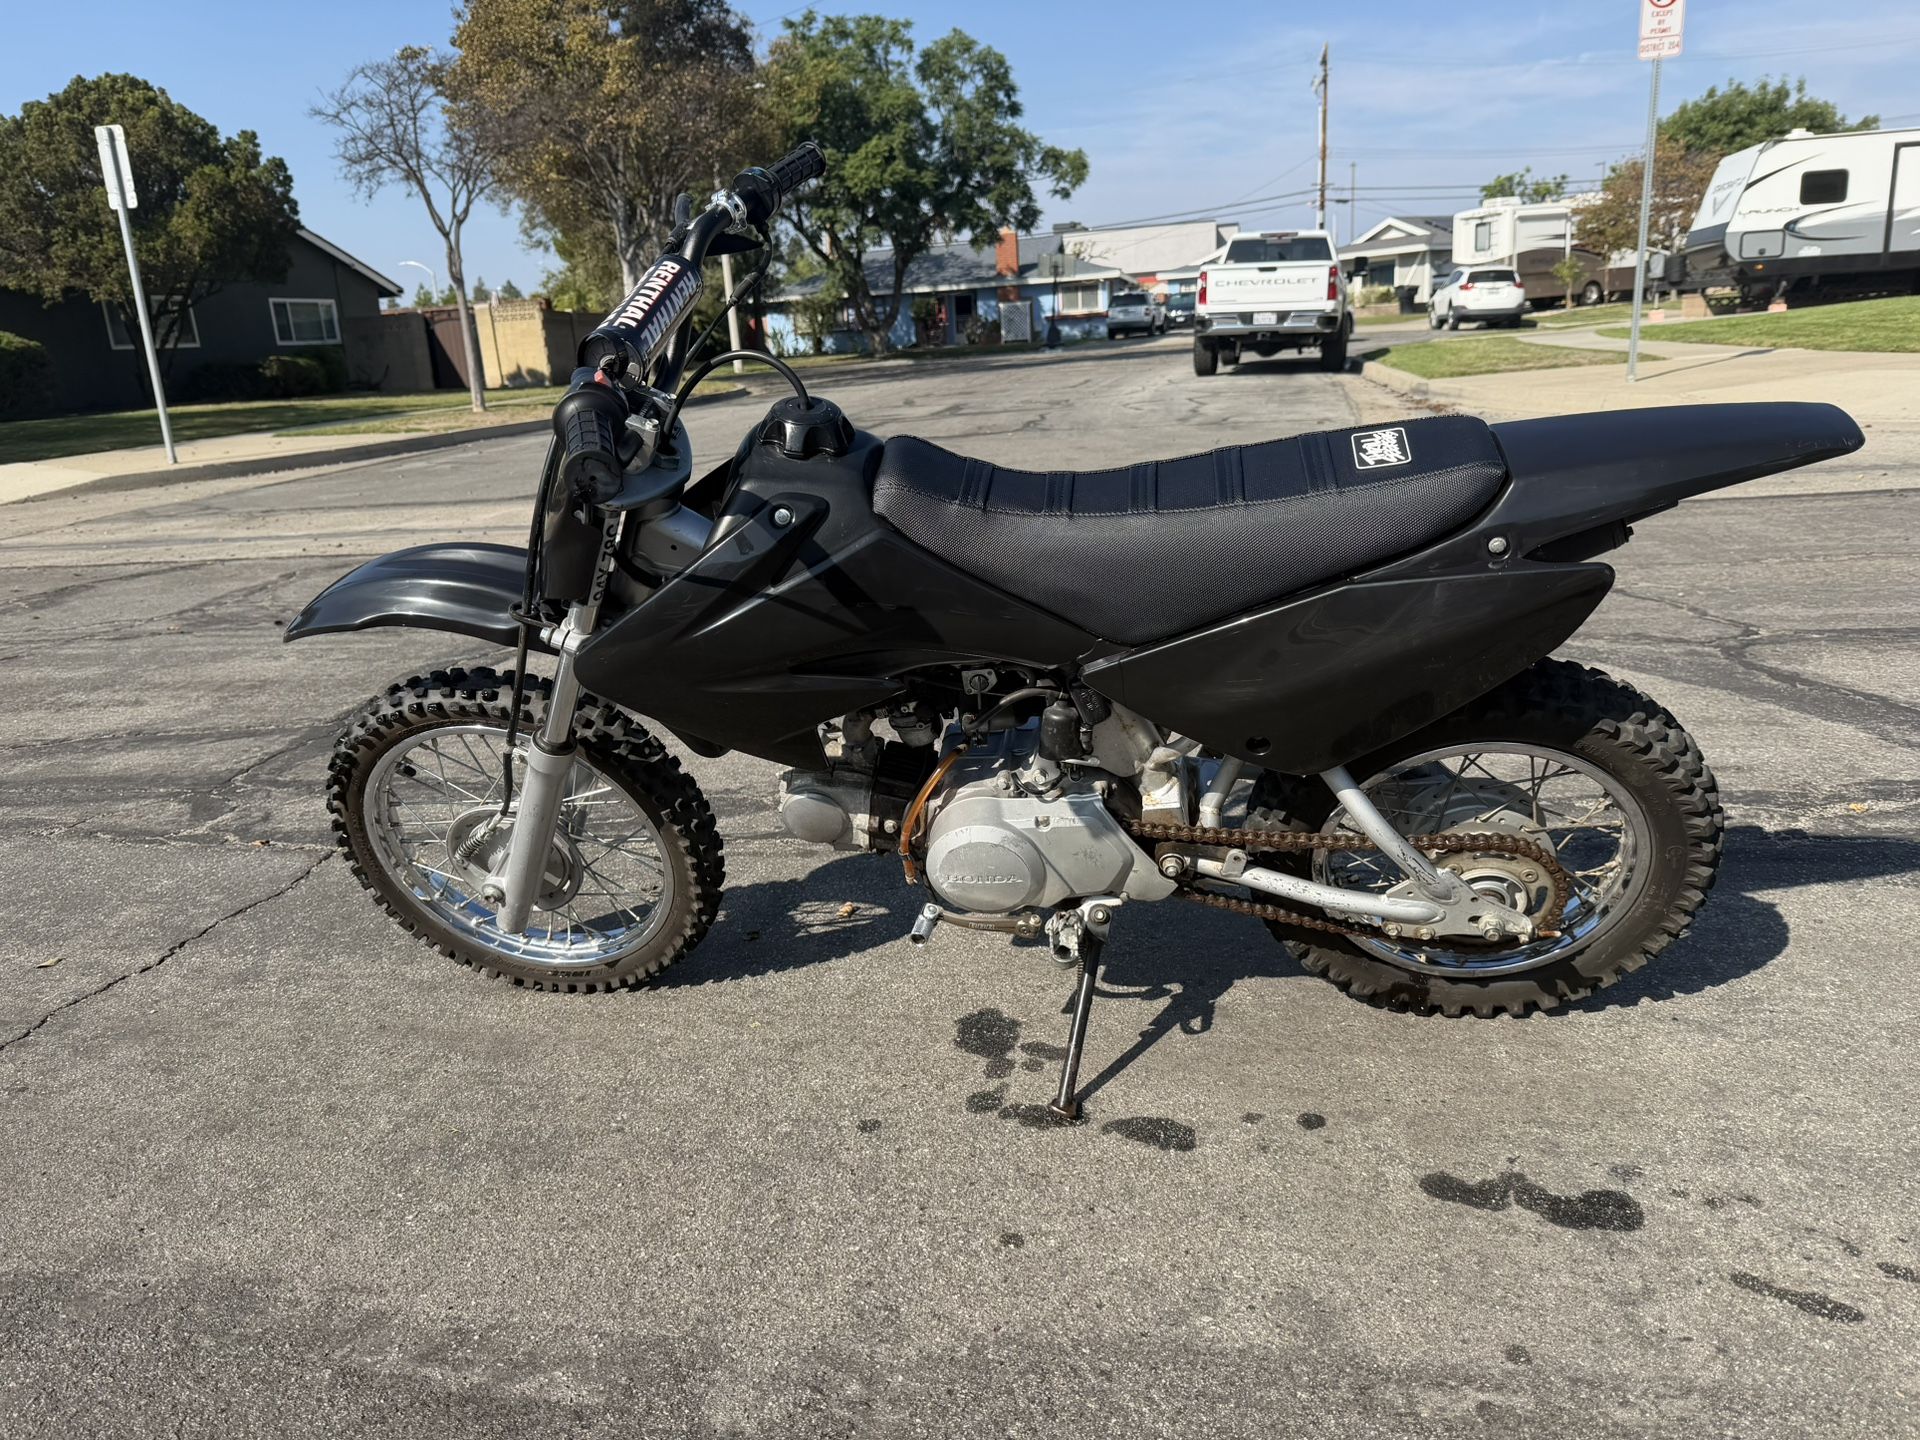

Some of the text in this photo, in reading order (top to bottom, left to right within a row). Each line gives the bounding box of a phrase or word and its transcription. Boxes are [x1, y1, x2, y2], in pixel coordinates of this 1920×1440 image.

[1651, 9, 1673, 18] EXCEPT
[1214, 277, 1320, 288] CHEVROLET
[613, 261, 681, 329] RENTHAL
[640, 271, 697, 346] RENTHAL
[945, 874, 1024, 884] HONDA
